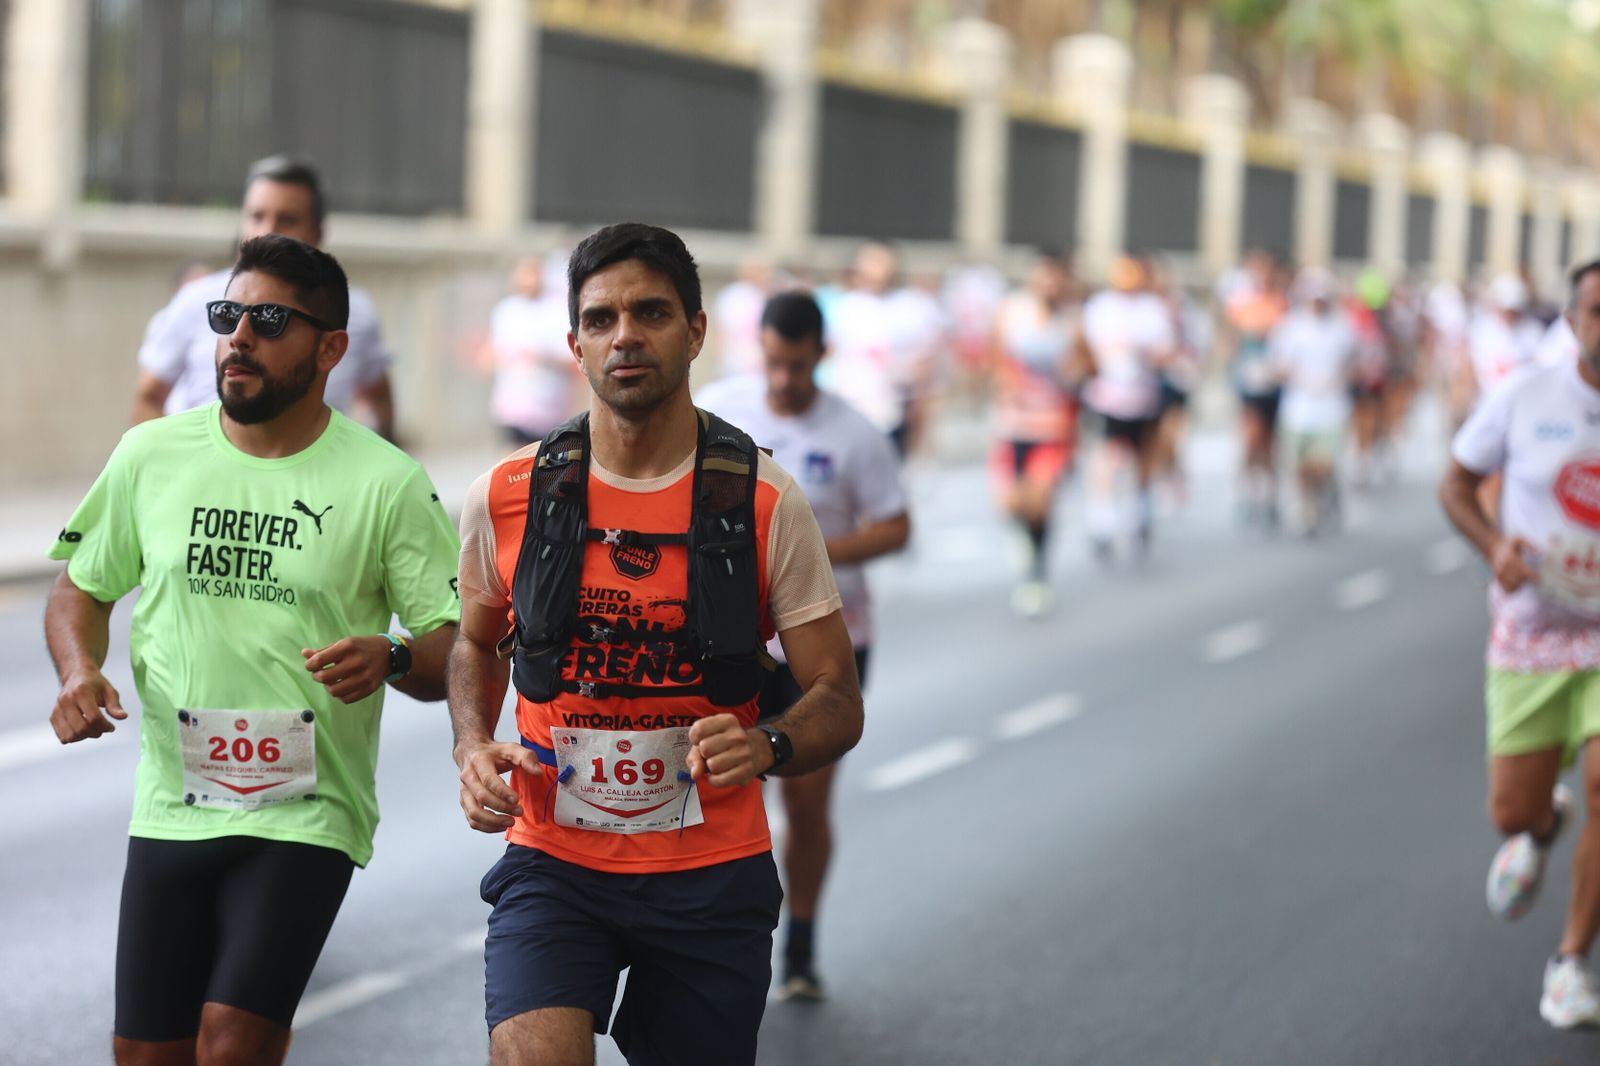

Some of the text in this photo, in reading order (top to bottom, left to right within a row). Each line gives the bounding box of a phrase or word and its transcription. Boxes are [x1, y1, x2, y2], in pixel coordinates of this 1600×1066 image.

[190, 507, 302, 550] FOREVER.
[187, 543, 278, 584] FASTER.
[188, 578, 210, 596] 10K
[214, 580, 245, 599] SAN
[208, 736, 281, 763] 206
[591, 757, 665, 785] 169
[580, 785, 596, 794] LUIS
[597, 786, 605, 794] A.
[606, 788, 642, 797] CALLEJA
